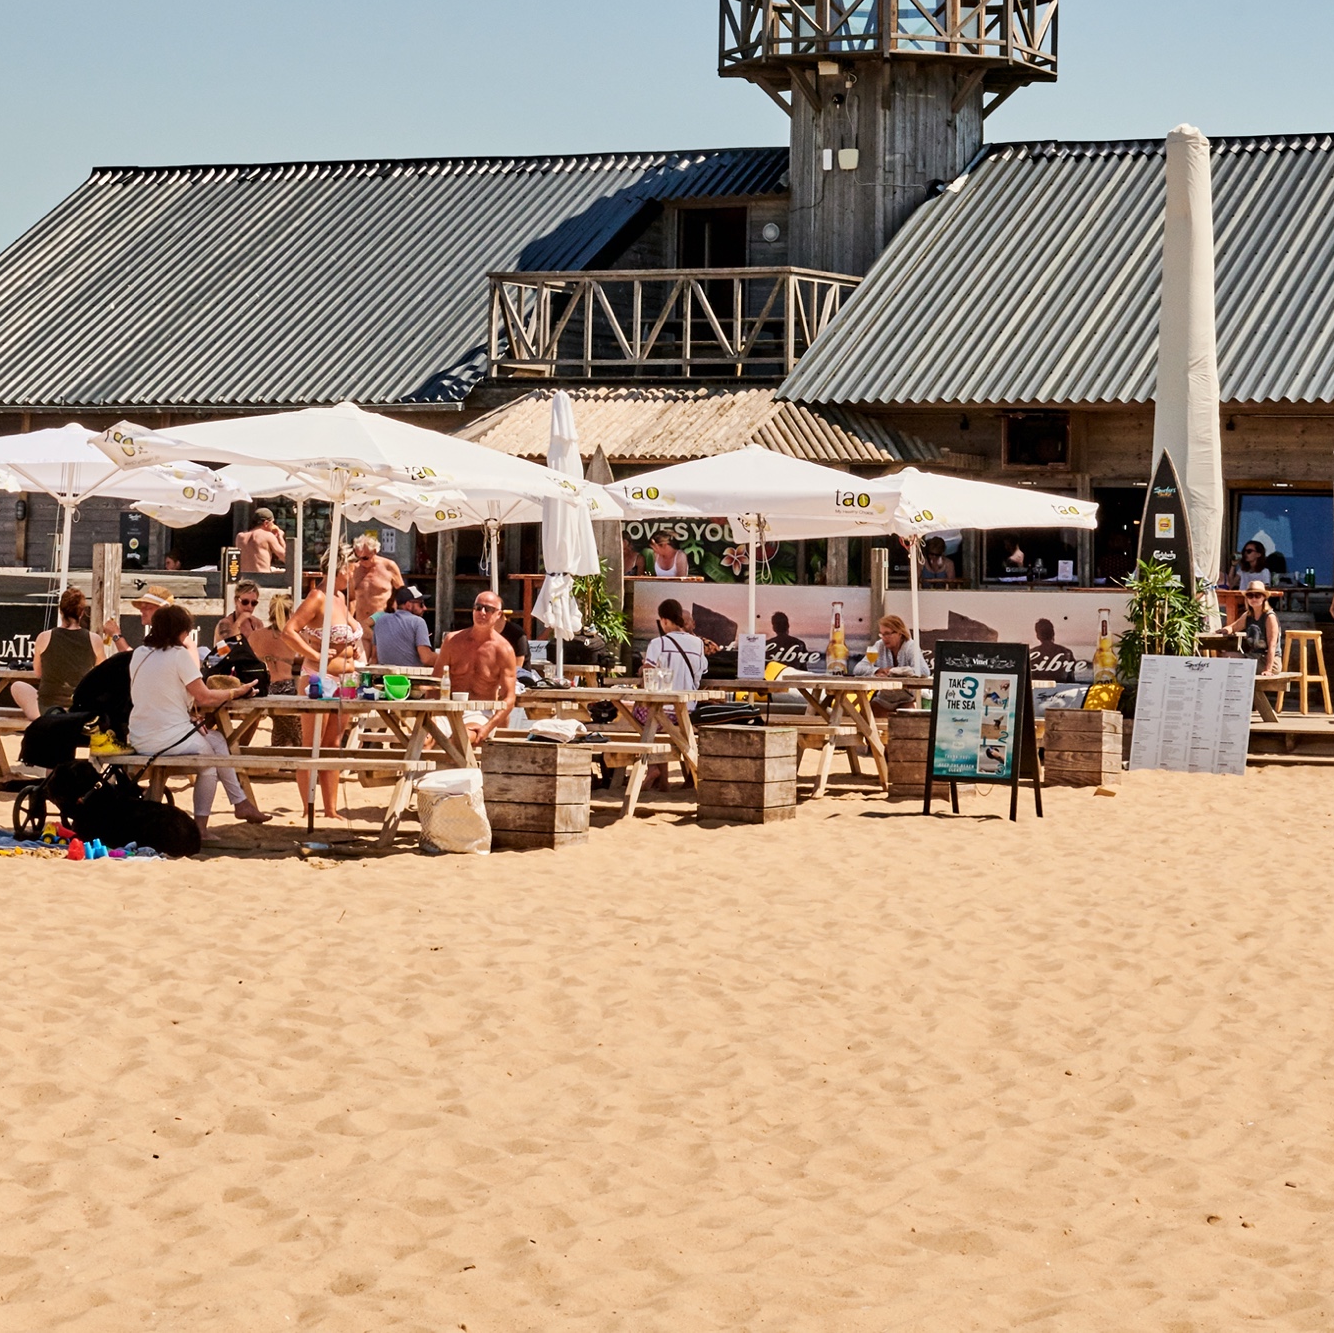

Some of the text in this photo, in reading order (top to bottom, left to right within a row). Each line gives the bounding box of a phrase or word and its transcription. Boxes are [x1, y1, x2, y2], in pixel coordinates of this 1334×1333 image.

[623, 485, 660, 500] tao
[835, 489, 871, 508] tao
[1051, 504, 1080, 515] tao
[622, 523, 689, 542] OVES
[765, 641, 821, 664] Libre
[1028, 651, 1087, 672] Libre
[948, 676, 979, 700] TAKE 3
[947, 700, 976, 711] THE SEA
